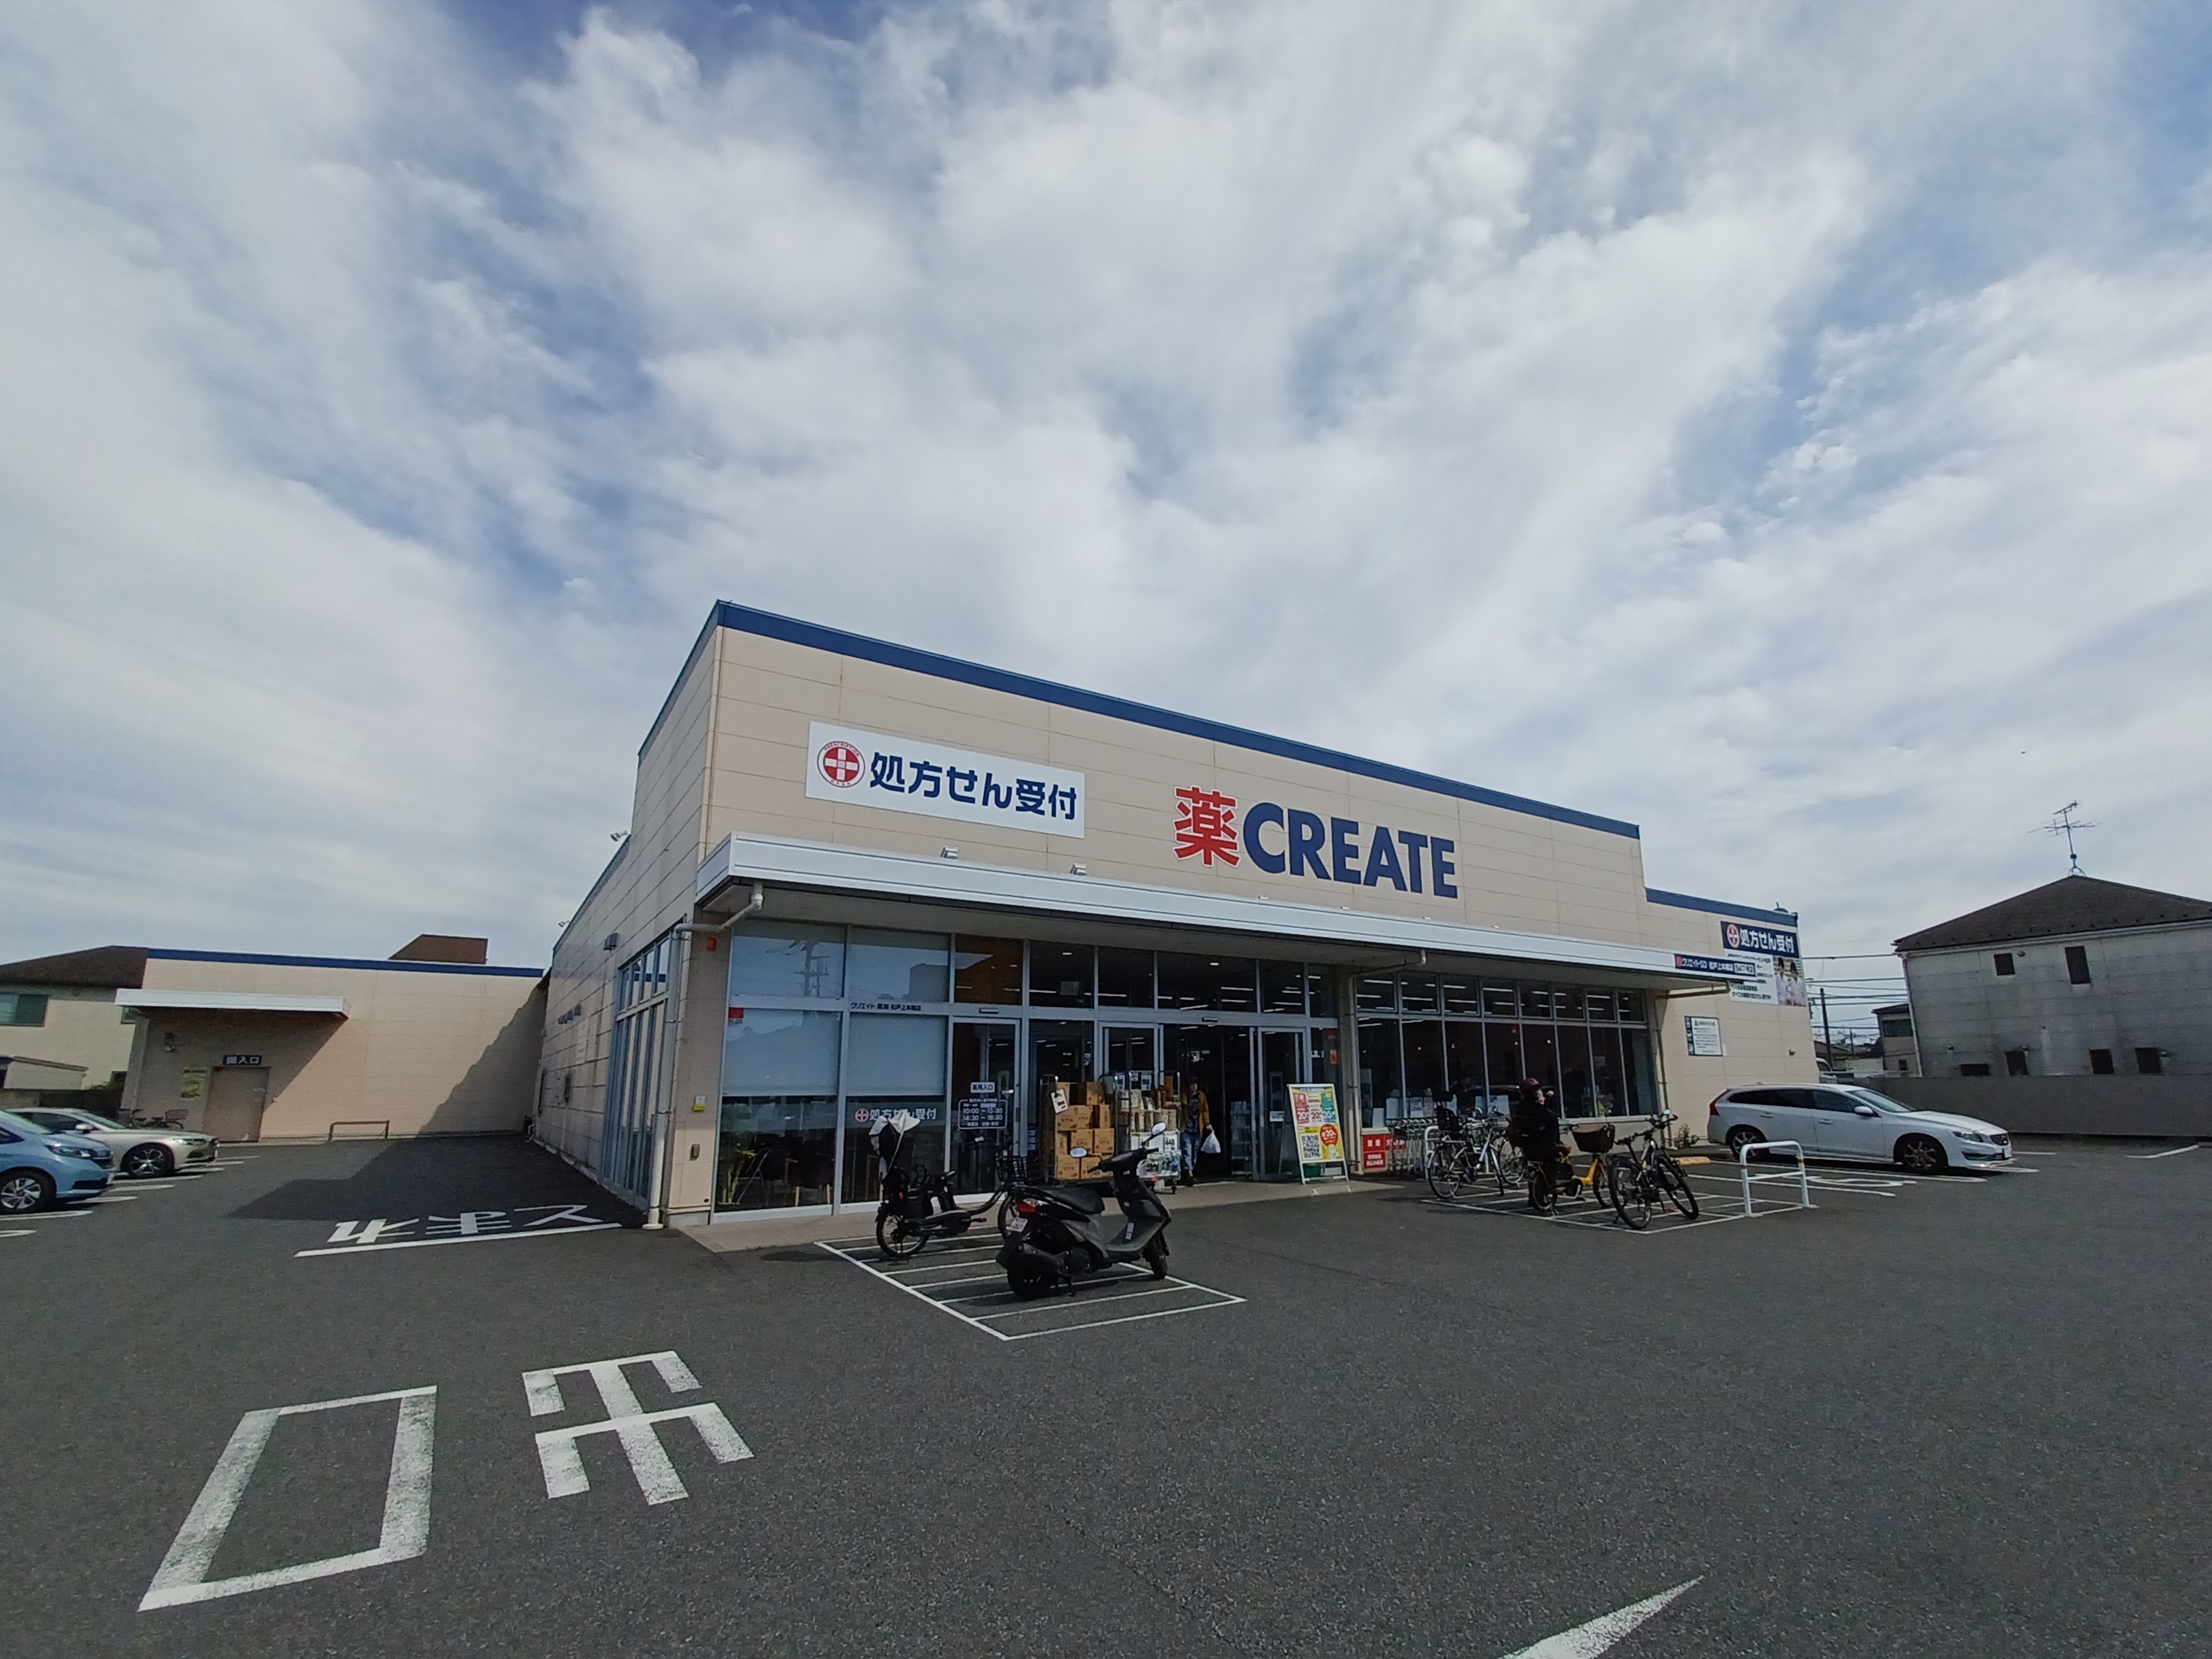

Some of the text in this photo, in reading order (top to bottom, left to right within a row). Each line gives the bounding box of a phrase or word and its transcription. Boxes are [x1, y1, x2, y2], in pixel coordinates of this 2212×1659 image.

[870, 752, 1077, 820] 処方せん受付
[1740, 928, 1795, 953] 処方せん受付
